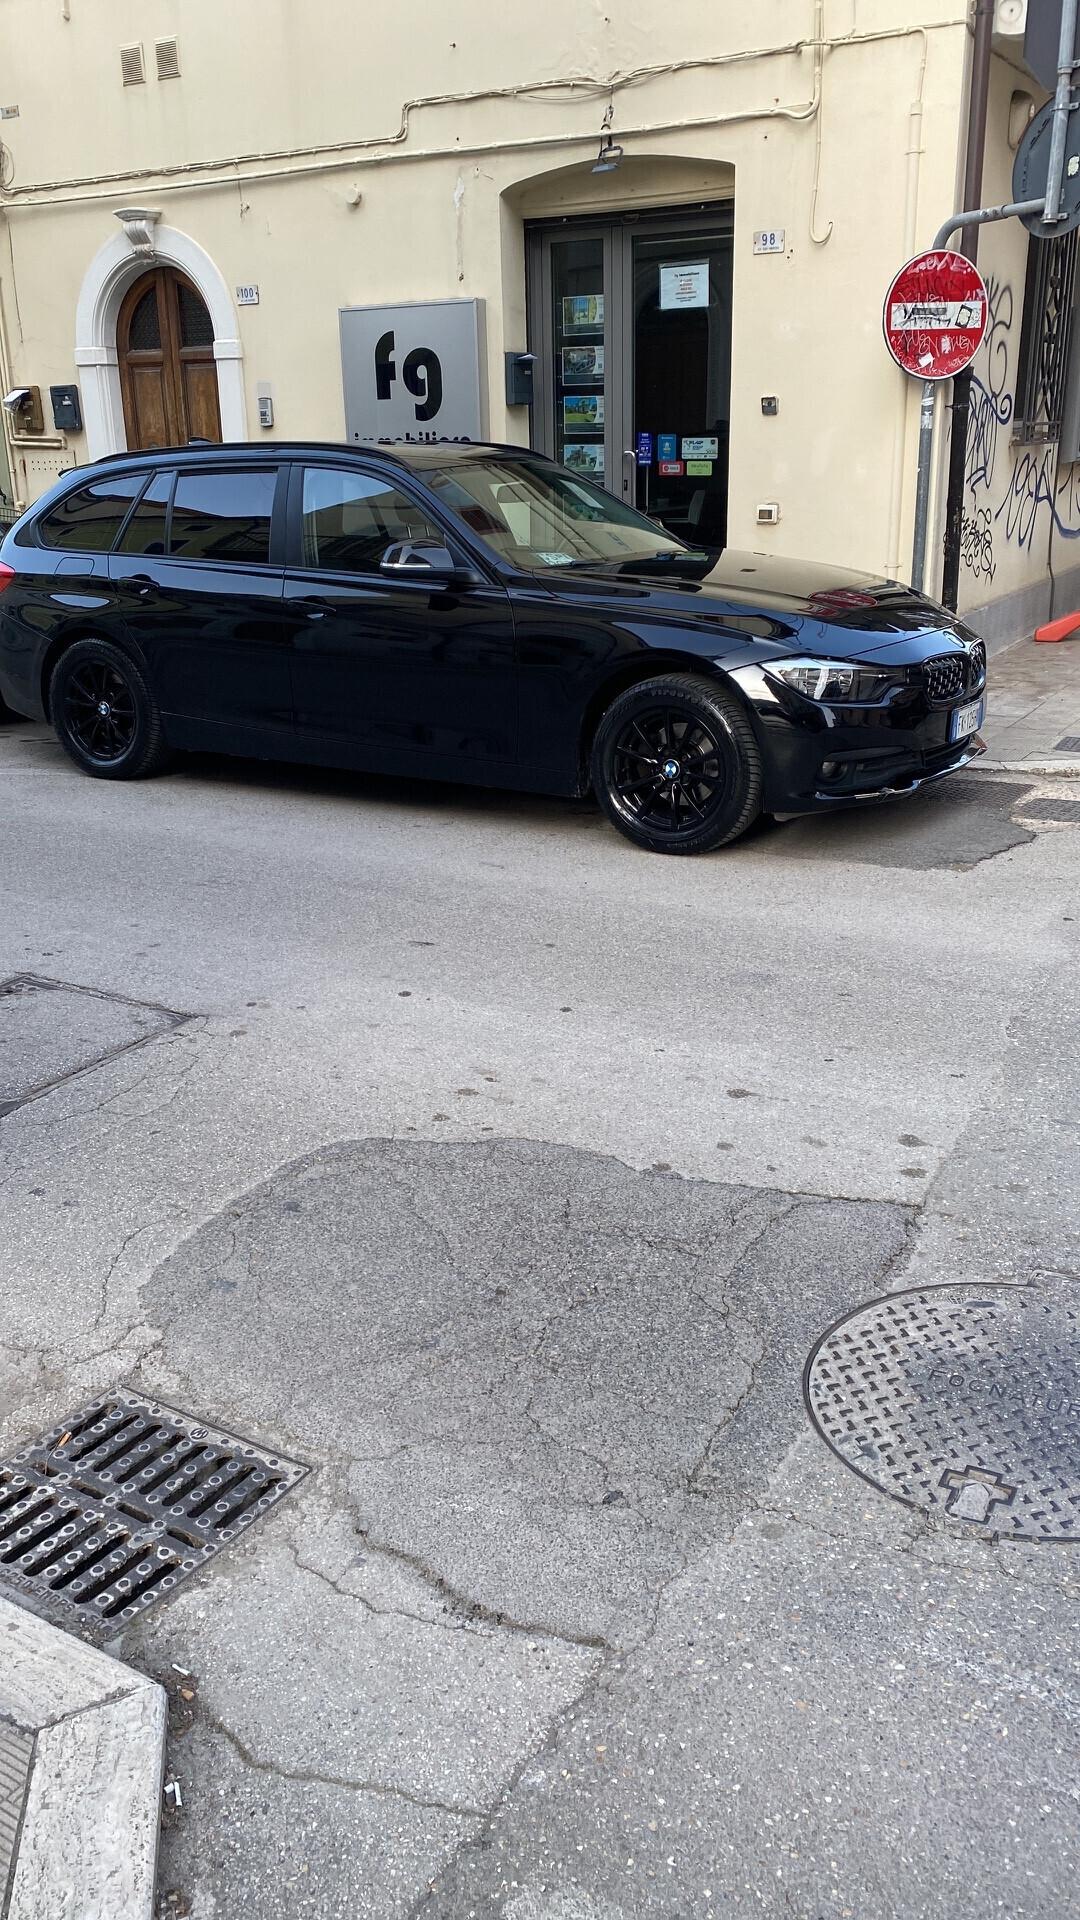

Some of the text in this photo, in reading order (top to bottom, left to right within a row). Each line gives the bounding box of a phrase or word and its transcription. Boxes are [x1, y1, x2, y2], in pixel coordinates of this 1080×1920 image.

[761, 232, 776, 246] 98
[240, 287, 254, 299] 100
[374, 330, 443, 422] fg
